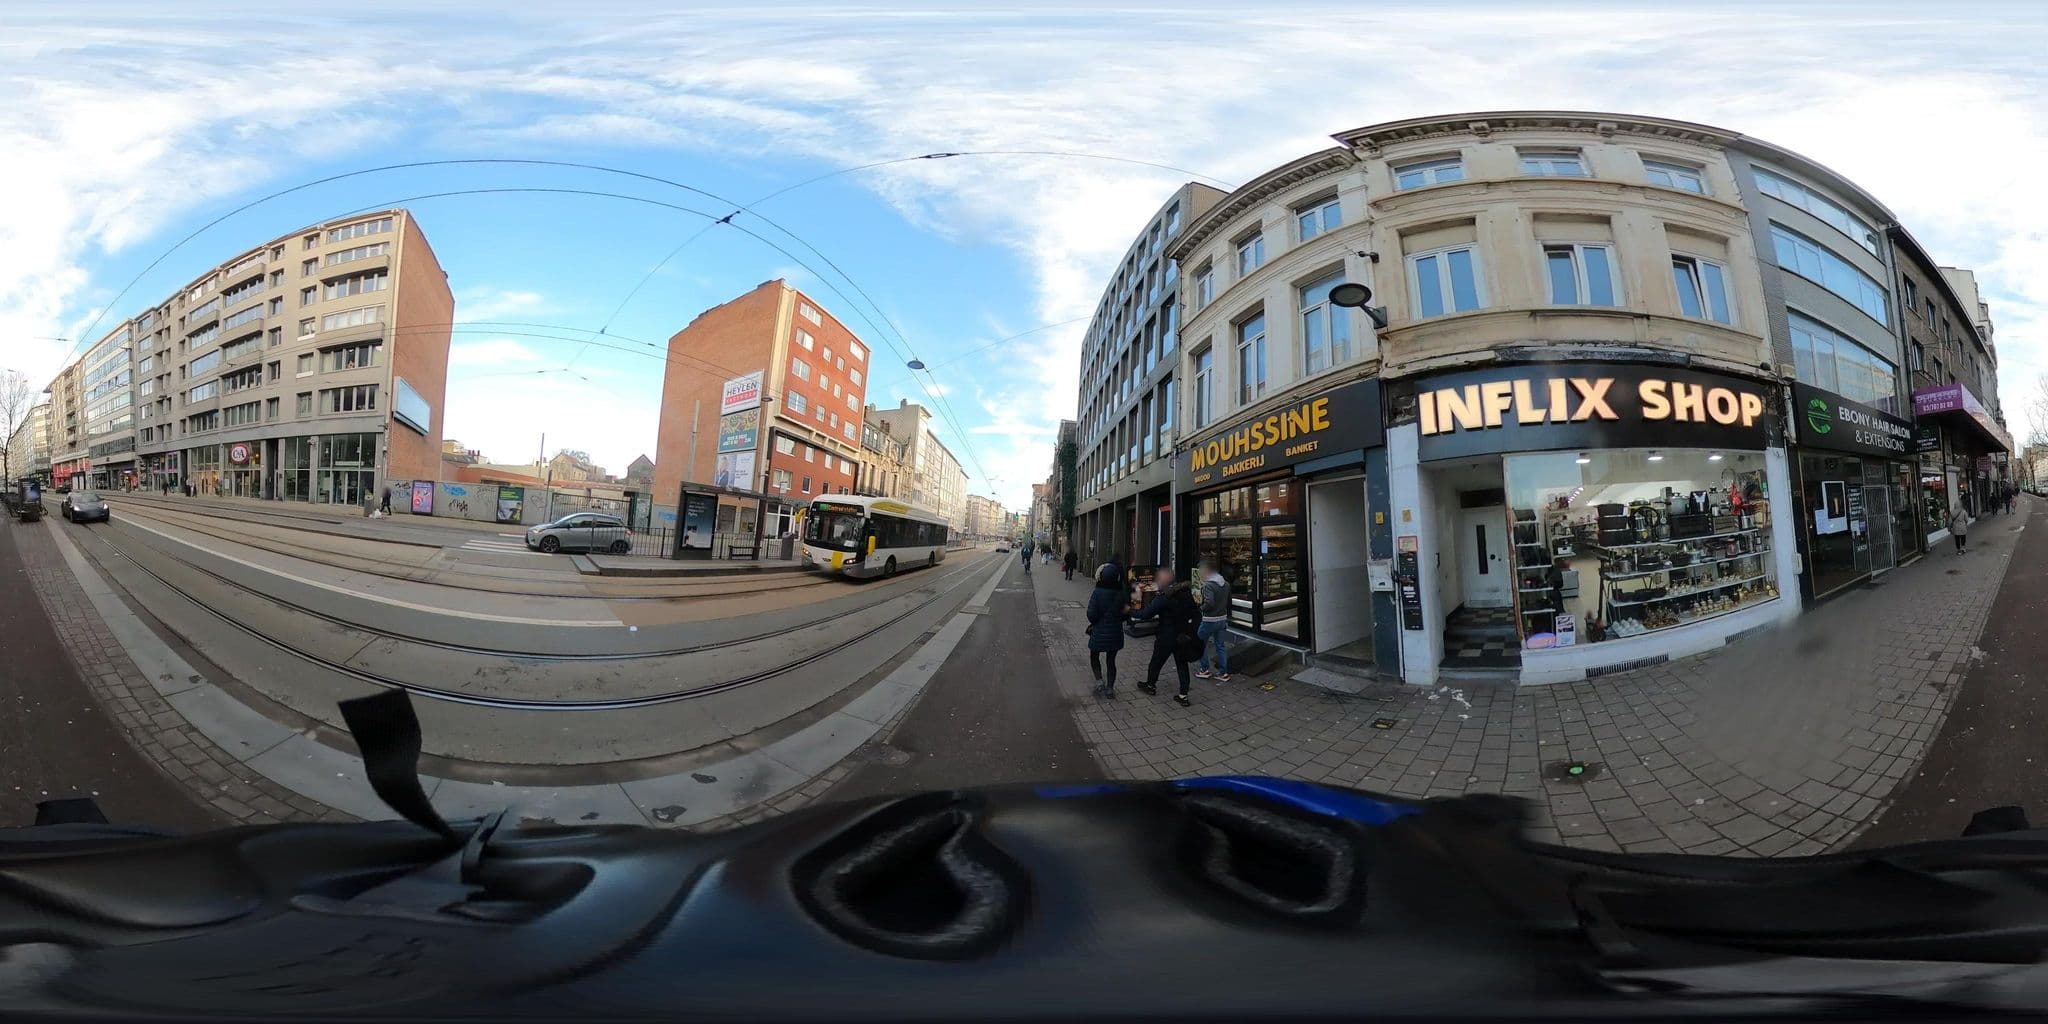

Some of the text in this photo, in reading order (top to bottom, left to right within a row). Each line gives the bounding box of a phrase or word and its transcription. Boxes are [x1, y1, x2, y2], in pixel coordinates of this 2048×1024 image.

[726, 381, 758, 396] HEYLEN
[1418, 378, 1762, 435] INFLIX SHOP
[1191, 397, 1330, 472] MOUHSSINE
[1838, 406, 1911, 440] EBONY HAIR SALON
[1285, 440, 1319, 457] BANKET
[1855, 430, 1862, 443] &
[1864, 431, 1905, 452] EXTENSIONS
[1222, 454, 1265, 477] BAKKERIJ
